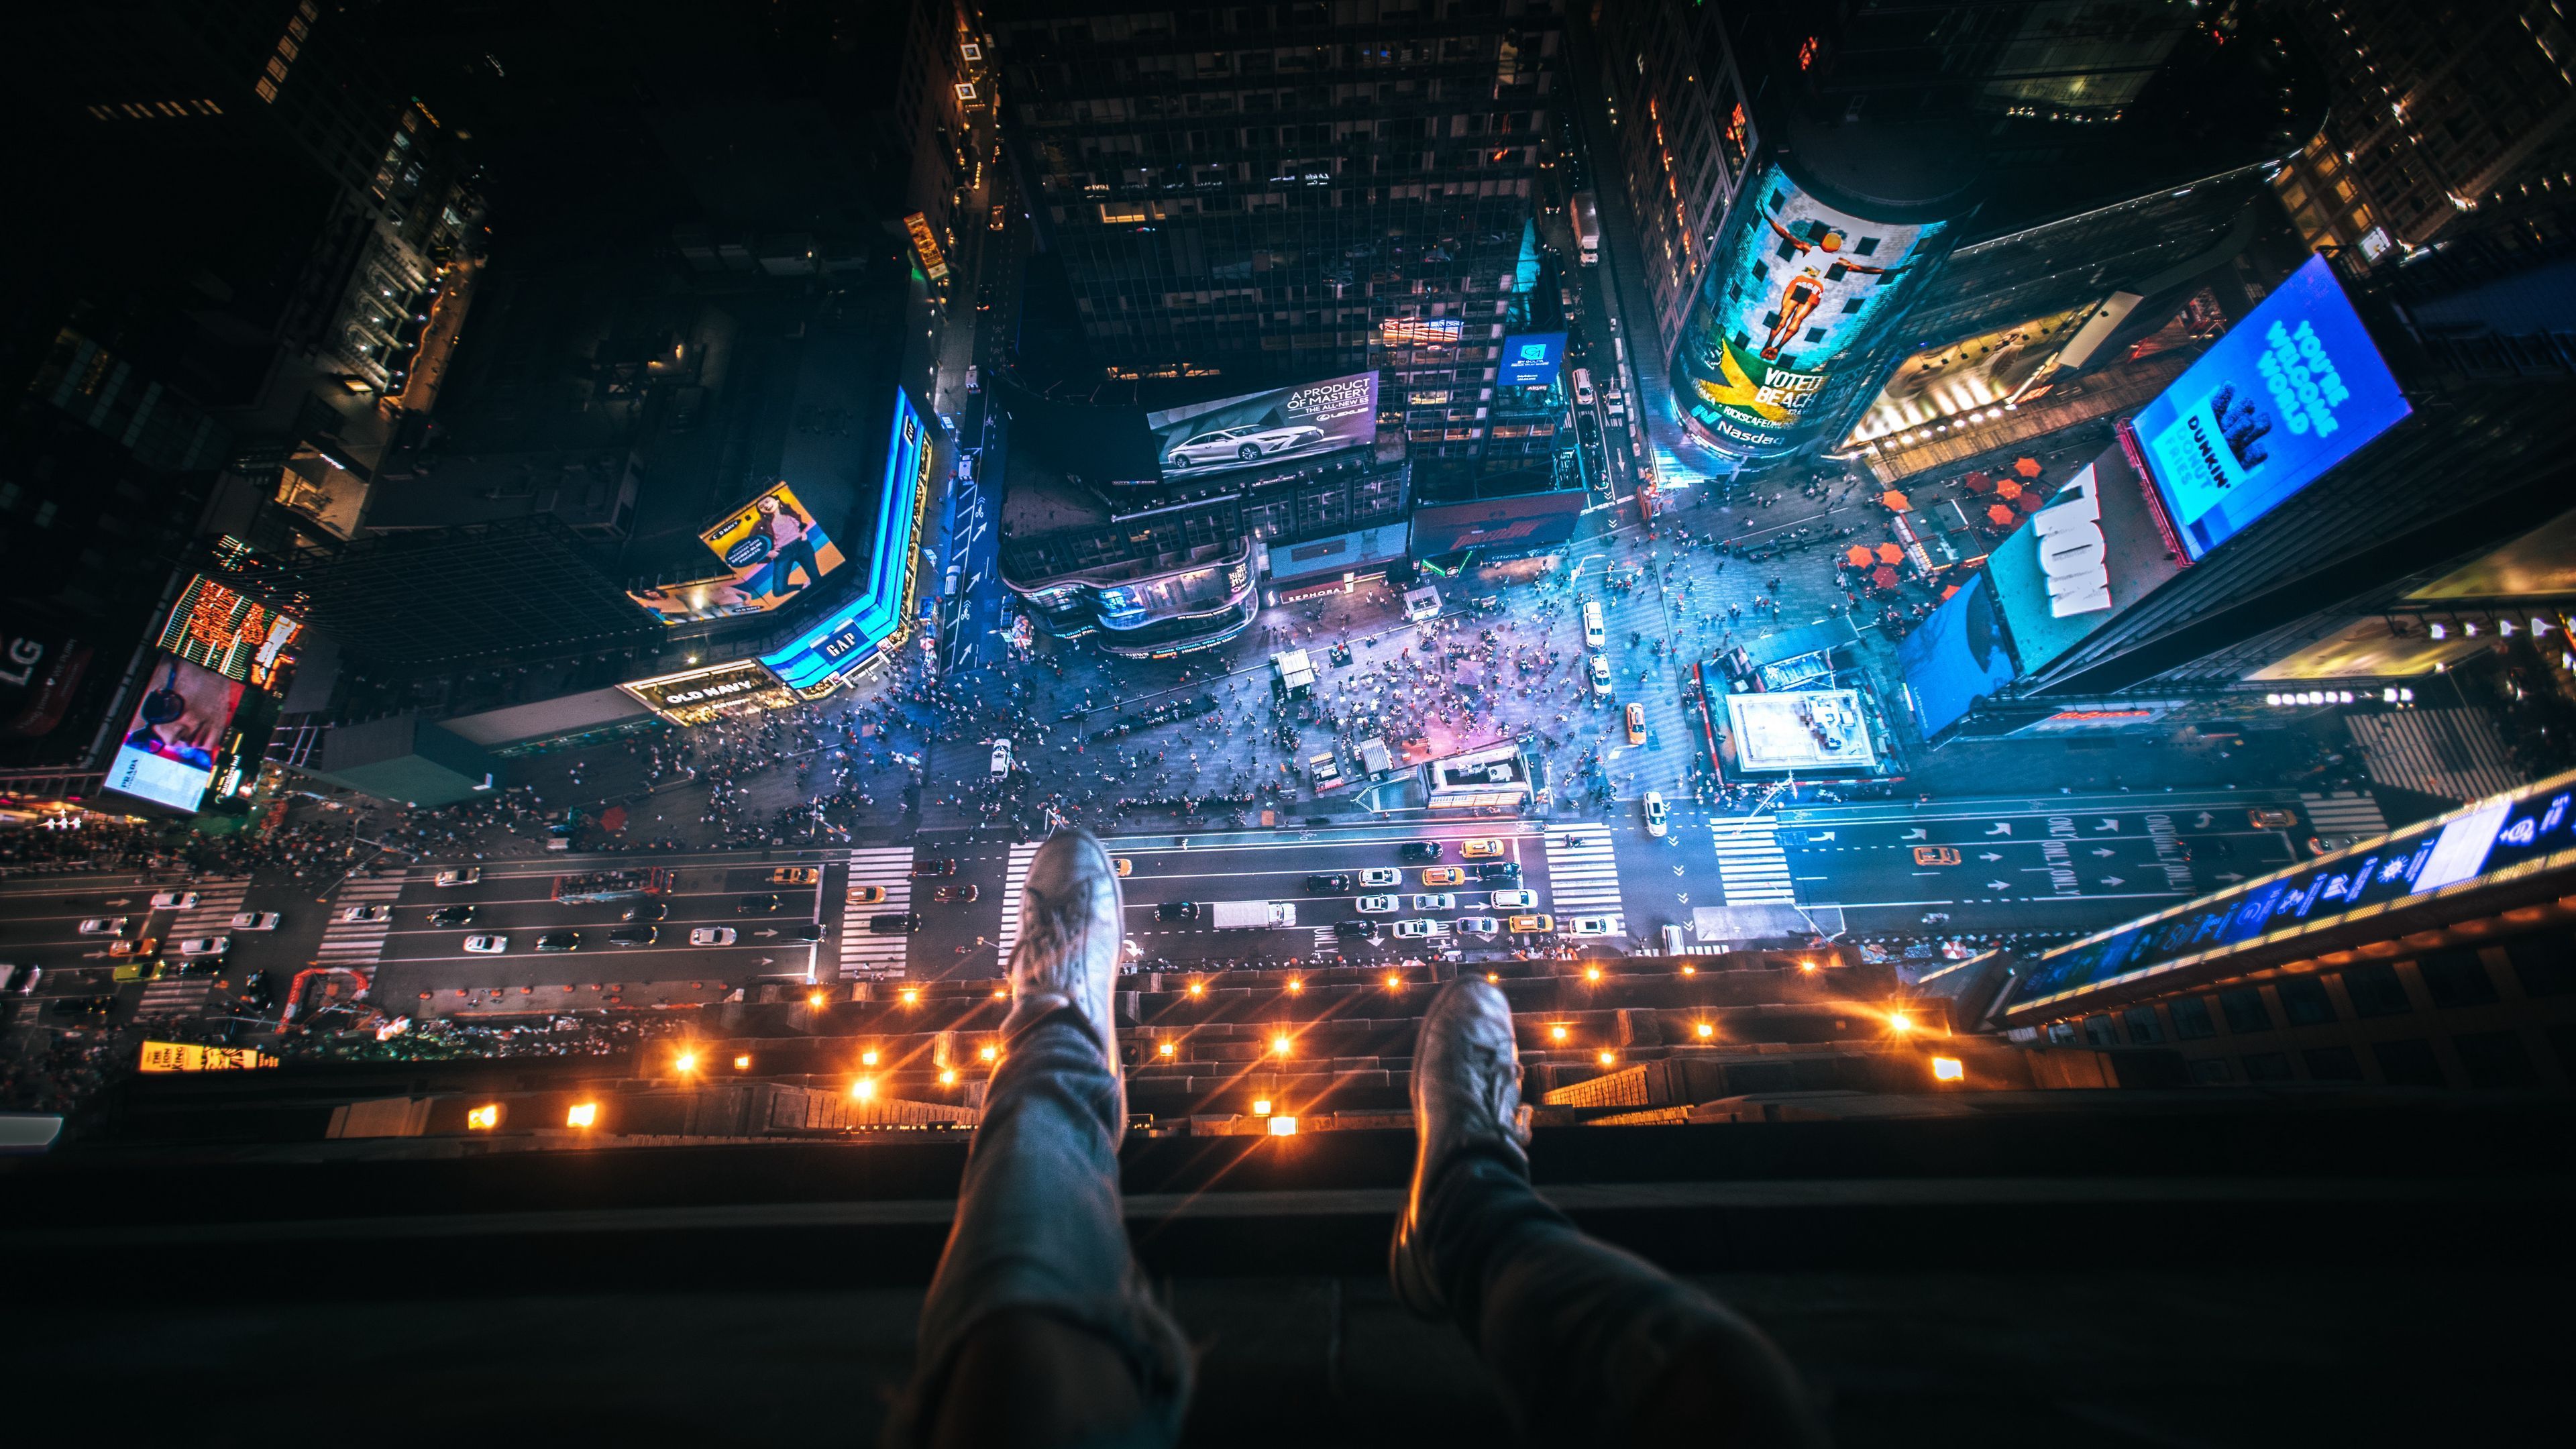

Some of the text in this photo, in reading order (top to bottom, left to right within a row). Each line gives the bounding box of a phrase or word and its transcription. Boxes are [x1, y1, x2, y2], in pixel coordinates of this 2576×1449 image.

[2294, 320, 2349, 407] YOU'RE
[1291, 378, 1370, 400] A PRODUCT
[1765, 367, 1823, 391] VOTED
[2267, 320, 2339, 437] WELCOME
[1287, 386, 1370, 409] OF MASTERY
[1755, 386, 1818, 408] BEACH
[2257, 350, 2310, 434] WORLD
[1322, 398, 1358, 411] ALL-NEW
[1331, 407, 1369, 418] LEXUS
[1717, 421, 1785, 445] Nasdaq
[2165, 437, 2193, 485] FRIES
[2176, 426, 2212, 489] DONUT
[2188, 415, 2231, 489] DUNKIN'
[712, 521, 739, 539] OD NAVY
[739, 548, 761, 564] POCKETS
[1288, 588, 1340, 602] SEPHORA
[826, 632, 855, 657] GAP
[0, 637, 44, 687] LG
[667, 680, 752, 704] OLD NAVY
[121, 758, 139, 788] PRADA
[2047, 816, 2079, 839] ONLY
[2145, 814, 2179, 836] ONLY
[2041, 841, 2072, 866] ONLY
[2050, 869, 2081, 895] ONLY
[153, 1051, 162, 1064] THE
[160, 1048, 172, 1068] LION
[171, 1047, 184, 1071] KING
